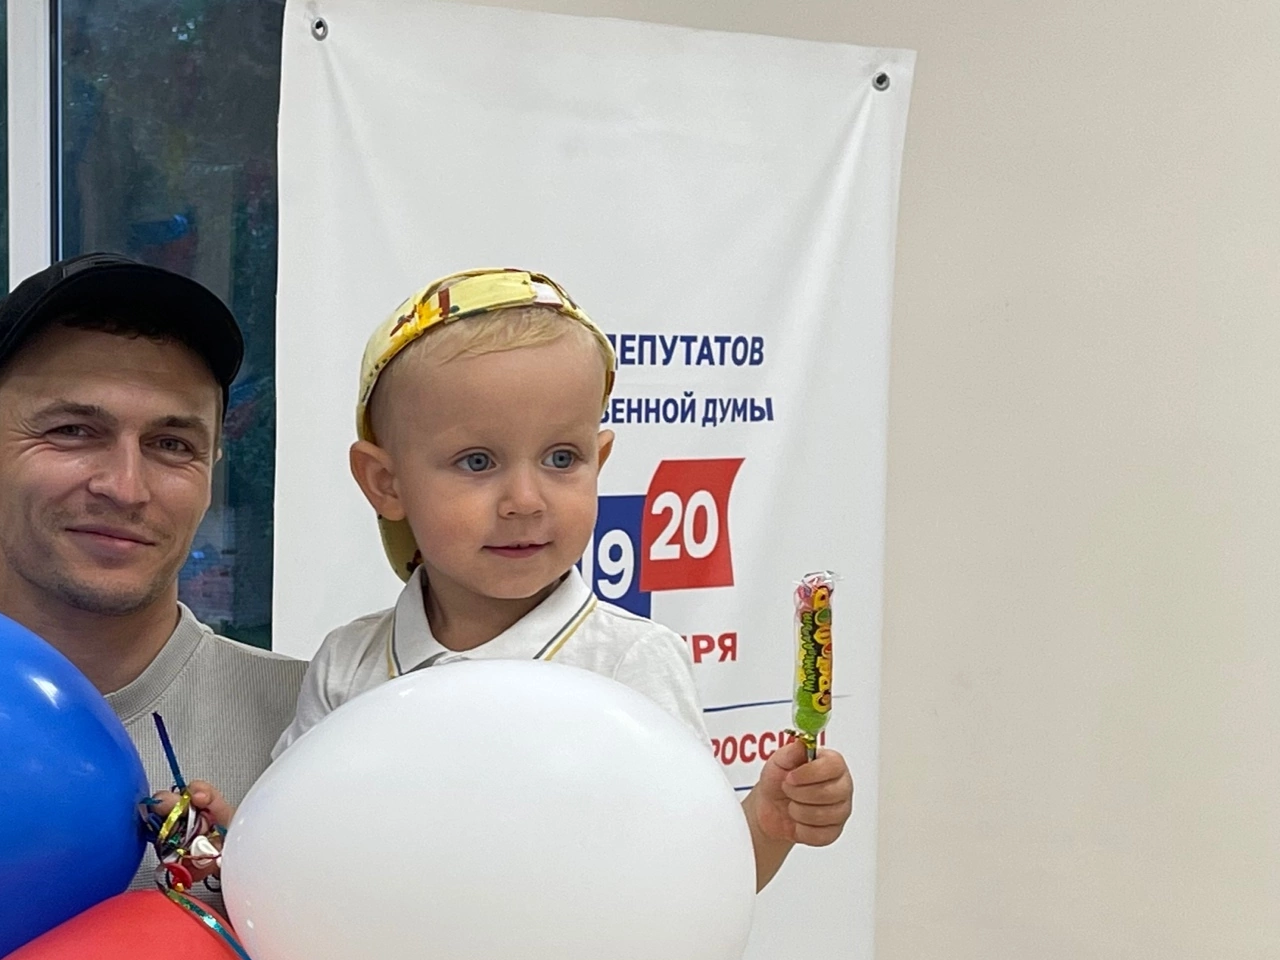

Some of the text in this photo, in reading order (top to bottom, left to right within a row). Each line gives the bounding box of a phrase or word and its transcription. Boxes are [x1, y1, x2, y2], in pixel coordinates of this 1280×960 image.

[702, 397, 775, 427] ДУМЫ
[650, 490, 719, 561] 20
[683, 632, 737, 664] РЯ
